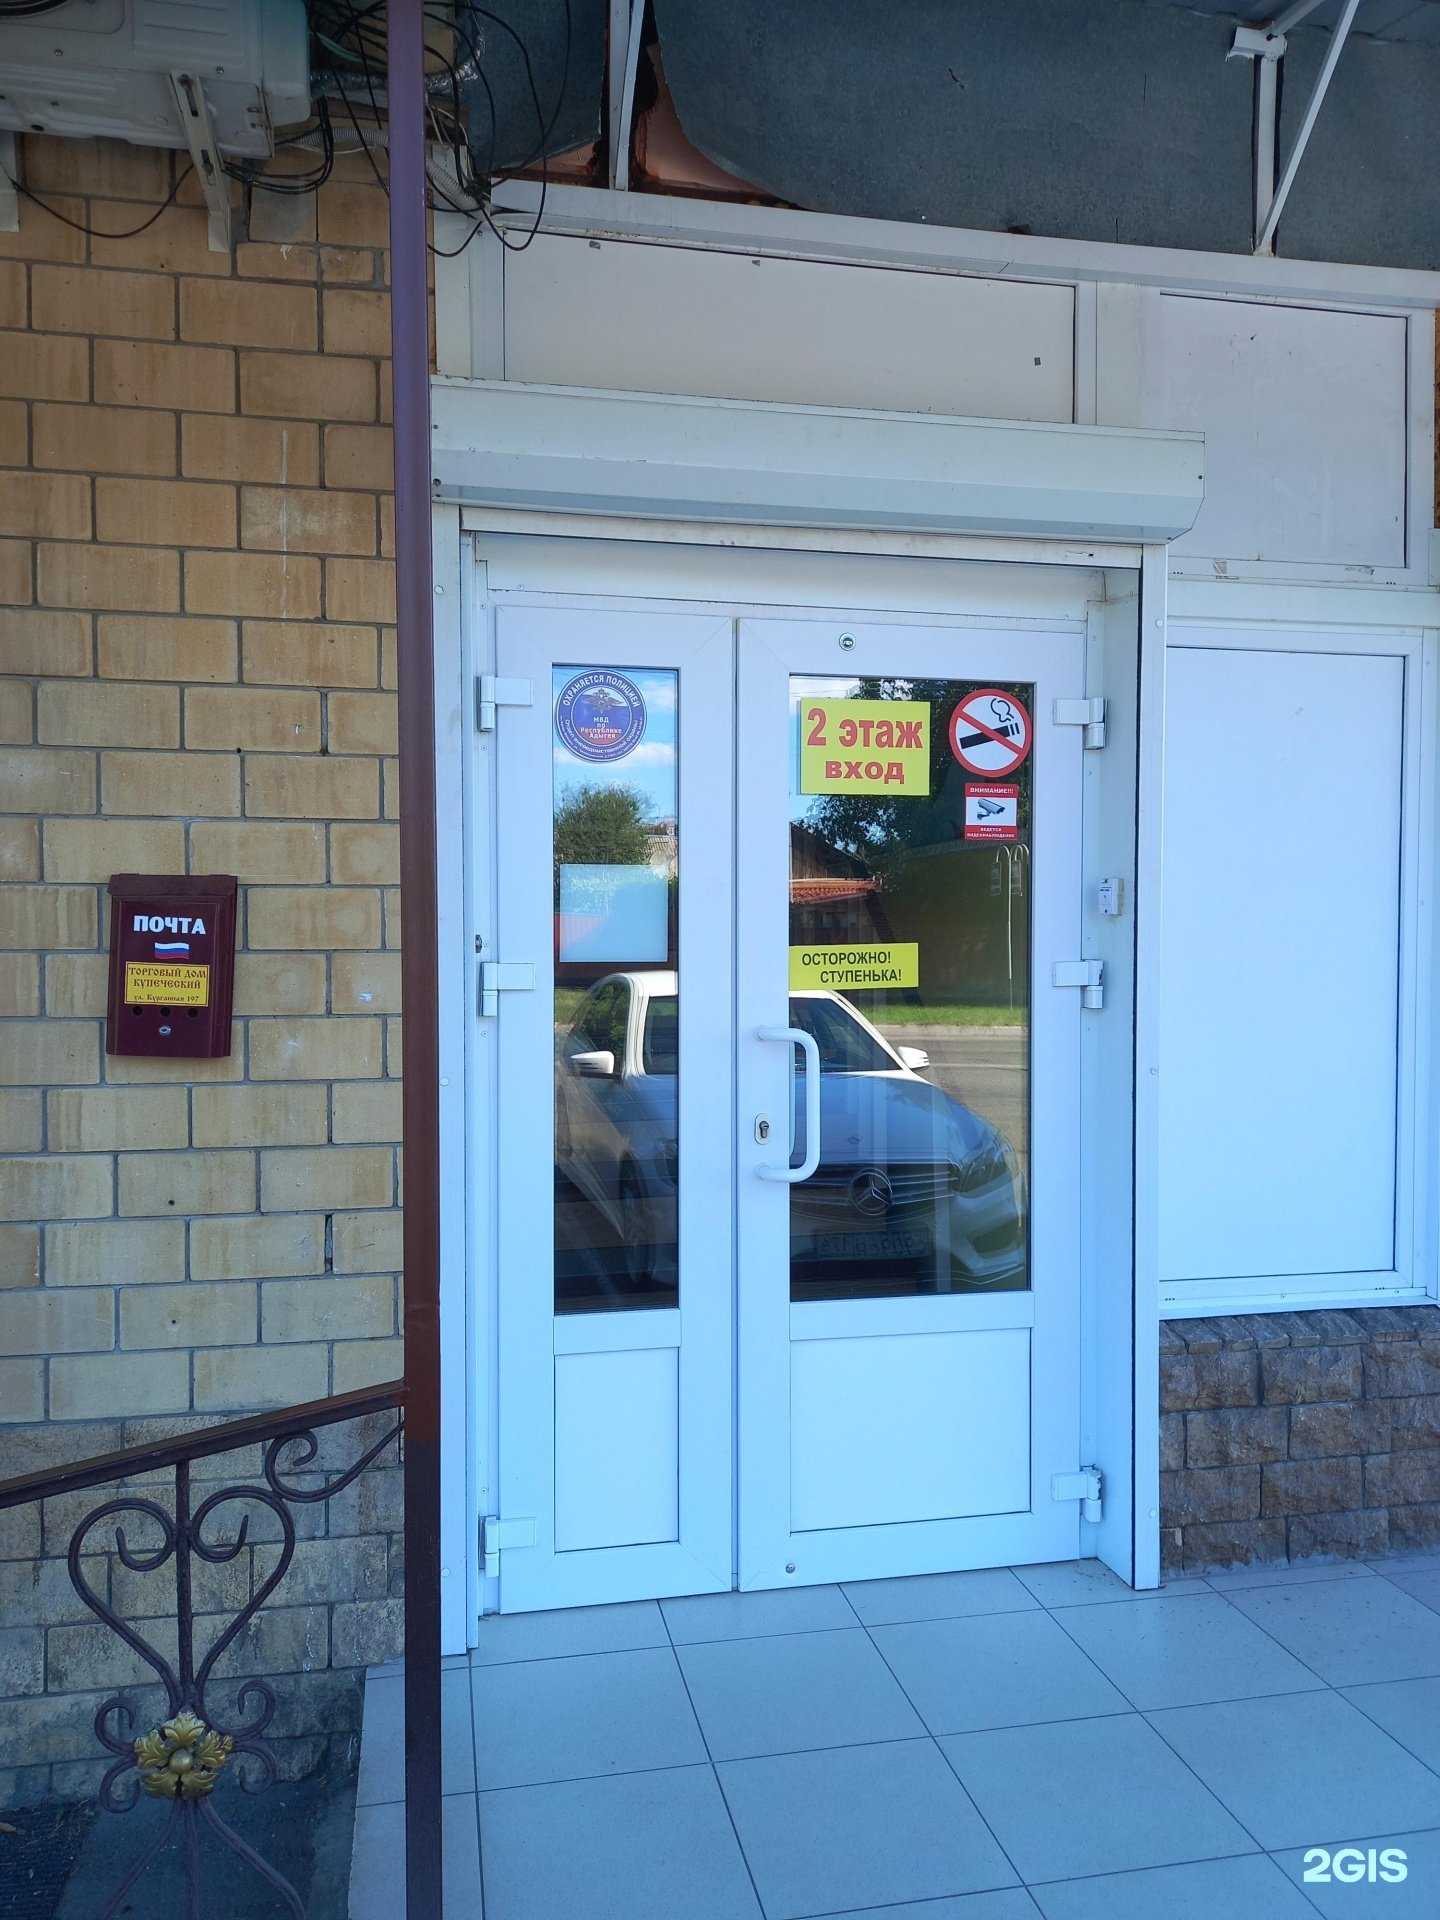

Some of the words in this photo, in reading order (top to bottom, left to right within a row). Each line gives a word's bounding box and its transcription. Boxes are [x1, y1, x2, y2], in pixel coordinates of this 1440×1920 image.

[563, 675, 605, 706] ОХРАНЯЕТСЯ
[606, 675, 641, 708] ПОЛИЦИЕЙ
[807, 707, 827, 746] 2
[839, 718, 923, 749] этаж
[825, 760, 905, 785] вход
[133, 915, 206, 935] ПОЧТА
[801, 951, 891, 966] ОСТОРОЖНО!
[128, 967, 182, 977] ТОРГОВЫЙ
[184, 969, 206, 978] ДОМ
[820, 969, 902, 983] СТУПЕНЬКА!
[133, 979, 201, 989] КУПЕЧЕСКИЙ
